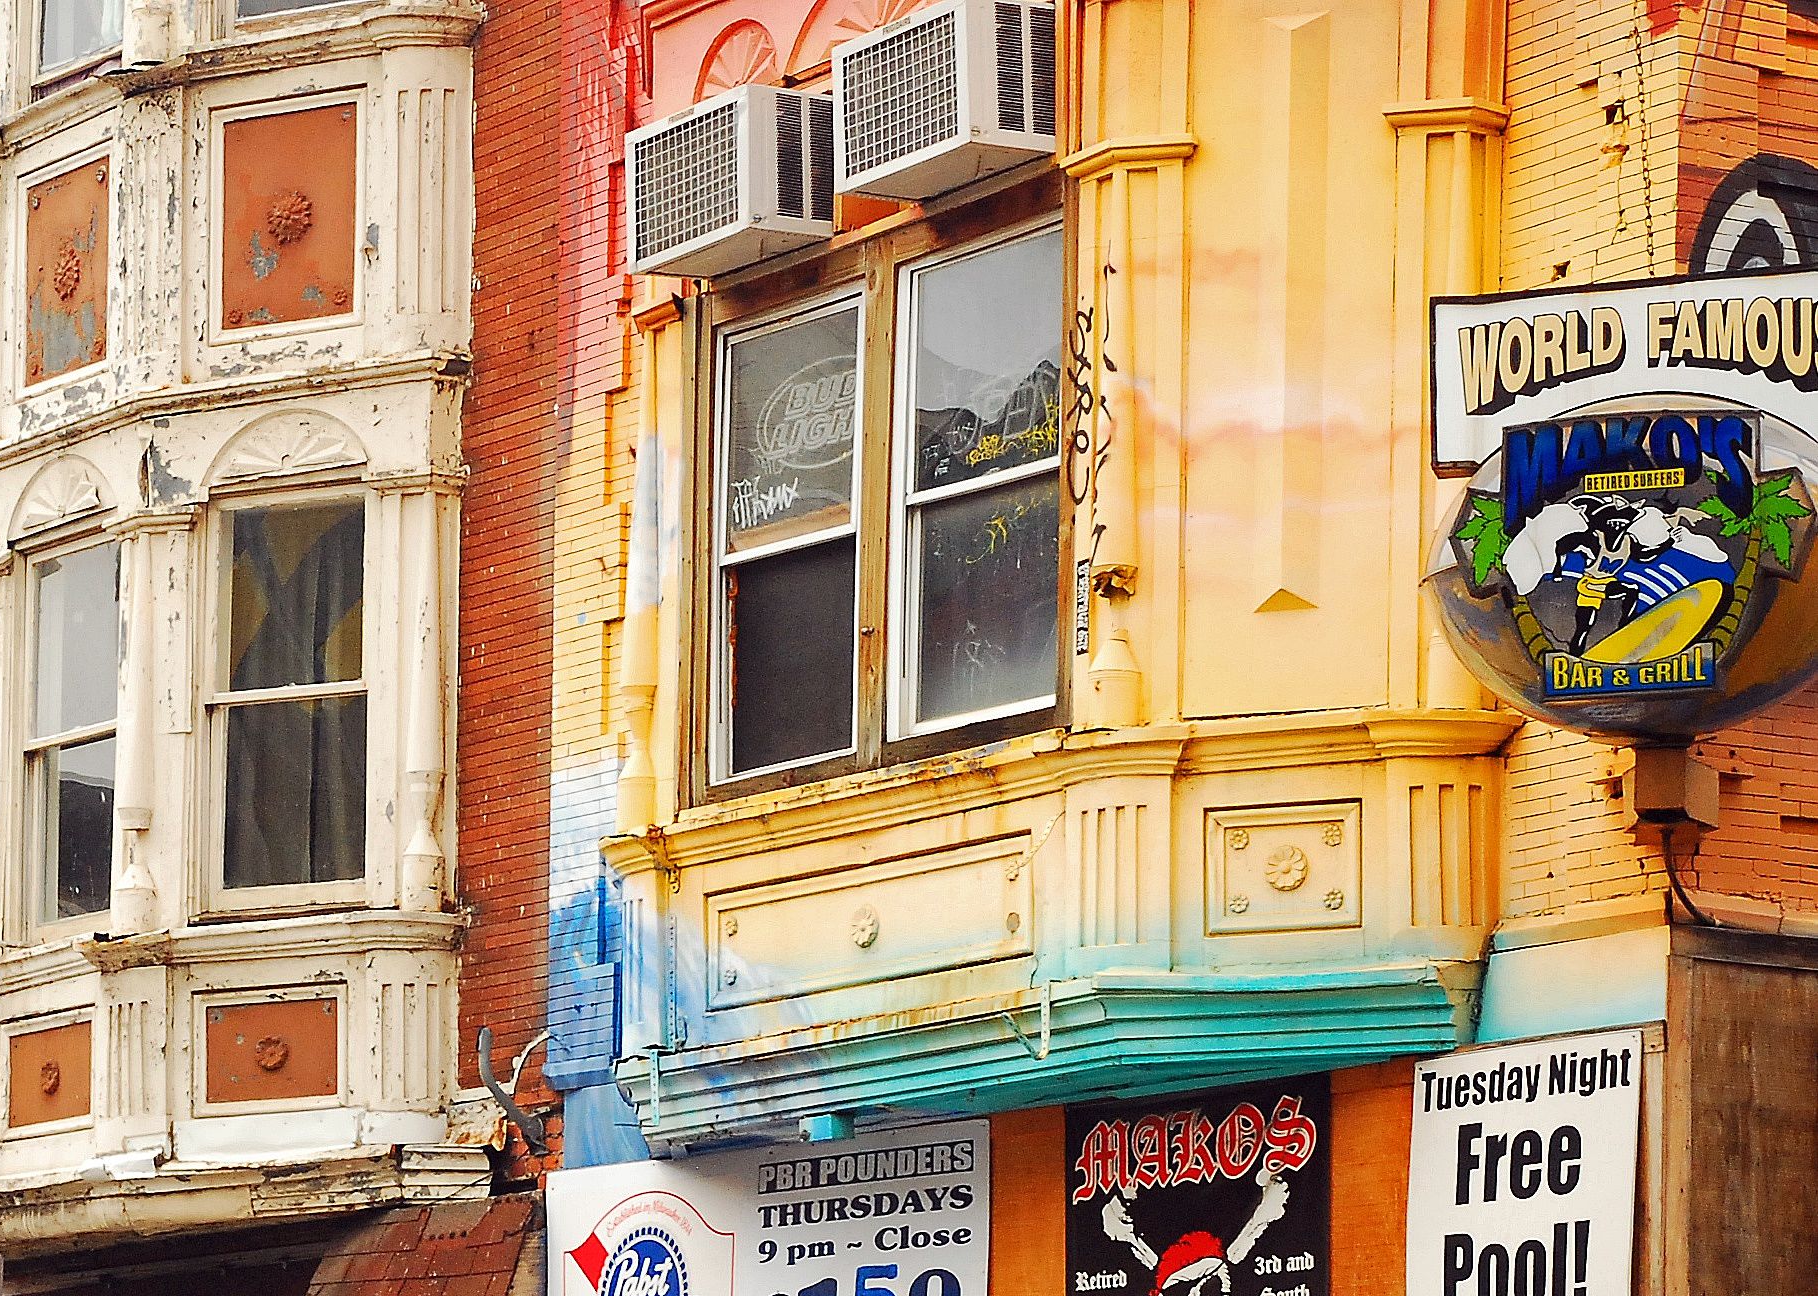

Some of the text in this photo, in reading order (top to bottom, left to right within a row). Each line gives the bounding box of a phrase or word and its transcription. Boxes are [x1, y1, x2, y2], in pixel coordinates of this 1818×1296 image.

[1458, 297, 1818, 414] WORLD FAMOU
[765, 405, 855, 459] LIGH
[1503, 414, 1753, 537] MAKO'S
[1586, 474, 1631, 491] RETIRED
[1553, 647, 1706, 690] BAR & GRILL
[1422, 1047, 1632, 1112] Tuesday Night
[759, 1142, 973, 1193] PBR POUNDERS
[1073, 1095, 1317, 1204] MAKOS
[1455, 1122, 1582, 1206] Free
[758, 1184, 974, 1229] THURSDAYS
[758, 1239, 778, 1264] 9
[786, 1239, 836, 1266] pm
[874, 1225, 972, 1251] Close
[1255, 1252, 1314, 1276] 3rd and
[1075, 1270, 1127, 1292] Retired
